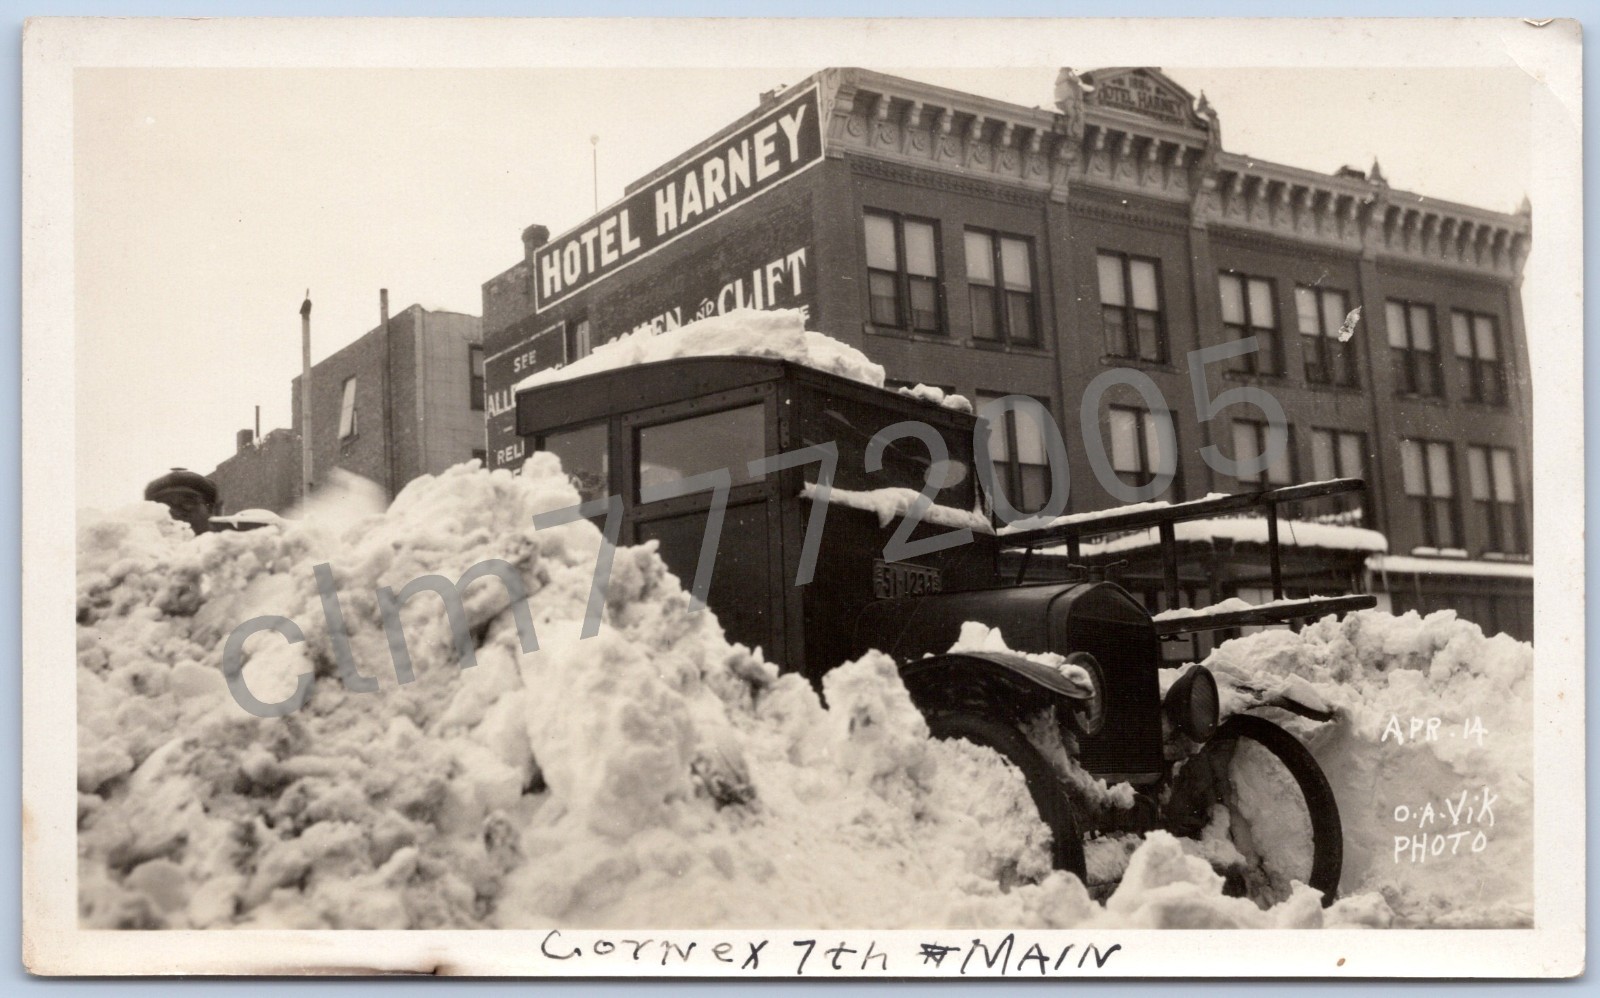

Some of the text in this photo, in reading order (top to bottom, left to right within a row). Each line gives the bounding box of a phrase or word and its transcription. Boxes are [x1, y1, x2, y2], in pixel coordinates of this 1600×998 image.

[541, 104, 806, 299] HOTEL HARNEY
[717, 247, 807, 317] CLIFT
[513, 350, 537, 373] SEE
[1394, 830, 1487, 863] PHOTO
[793, 940, 887, 974] 7th
